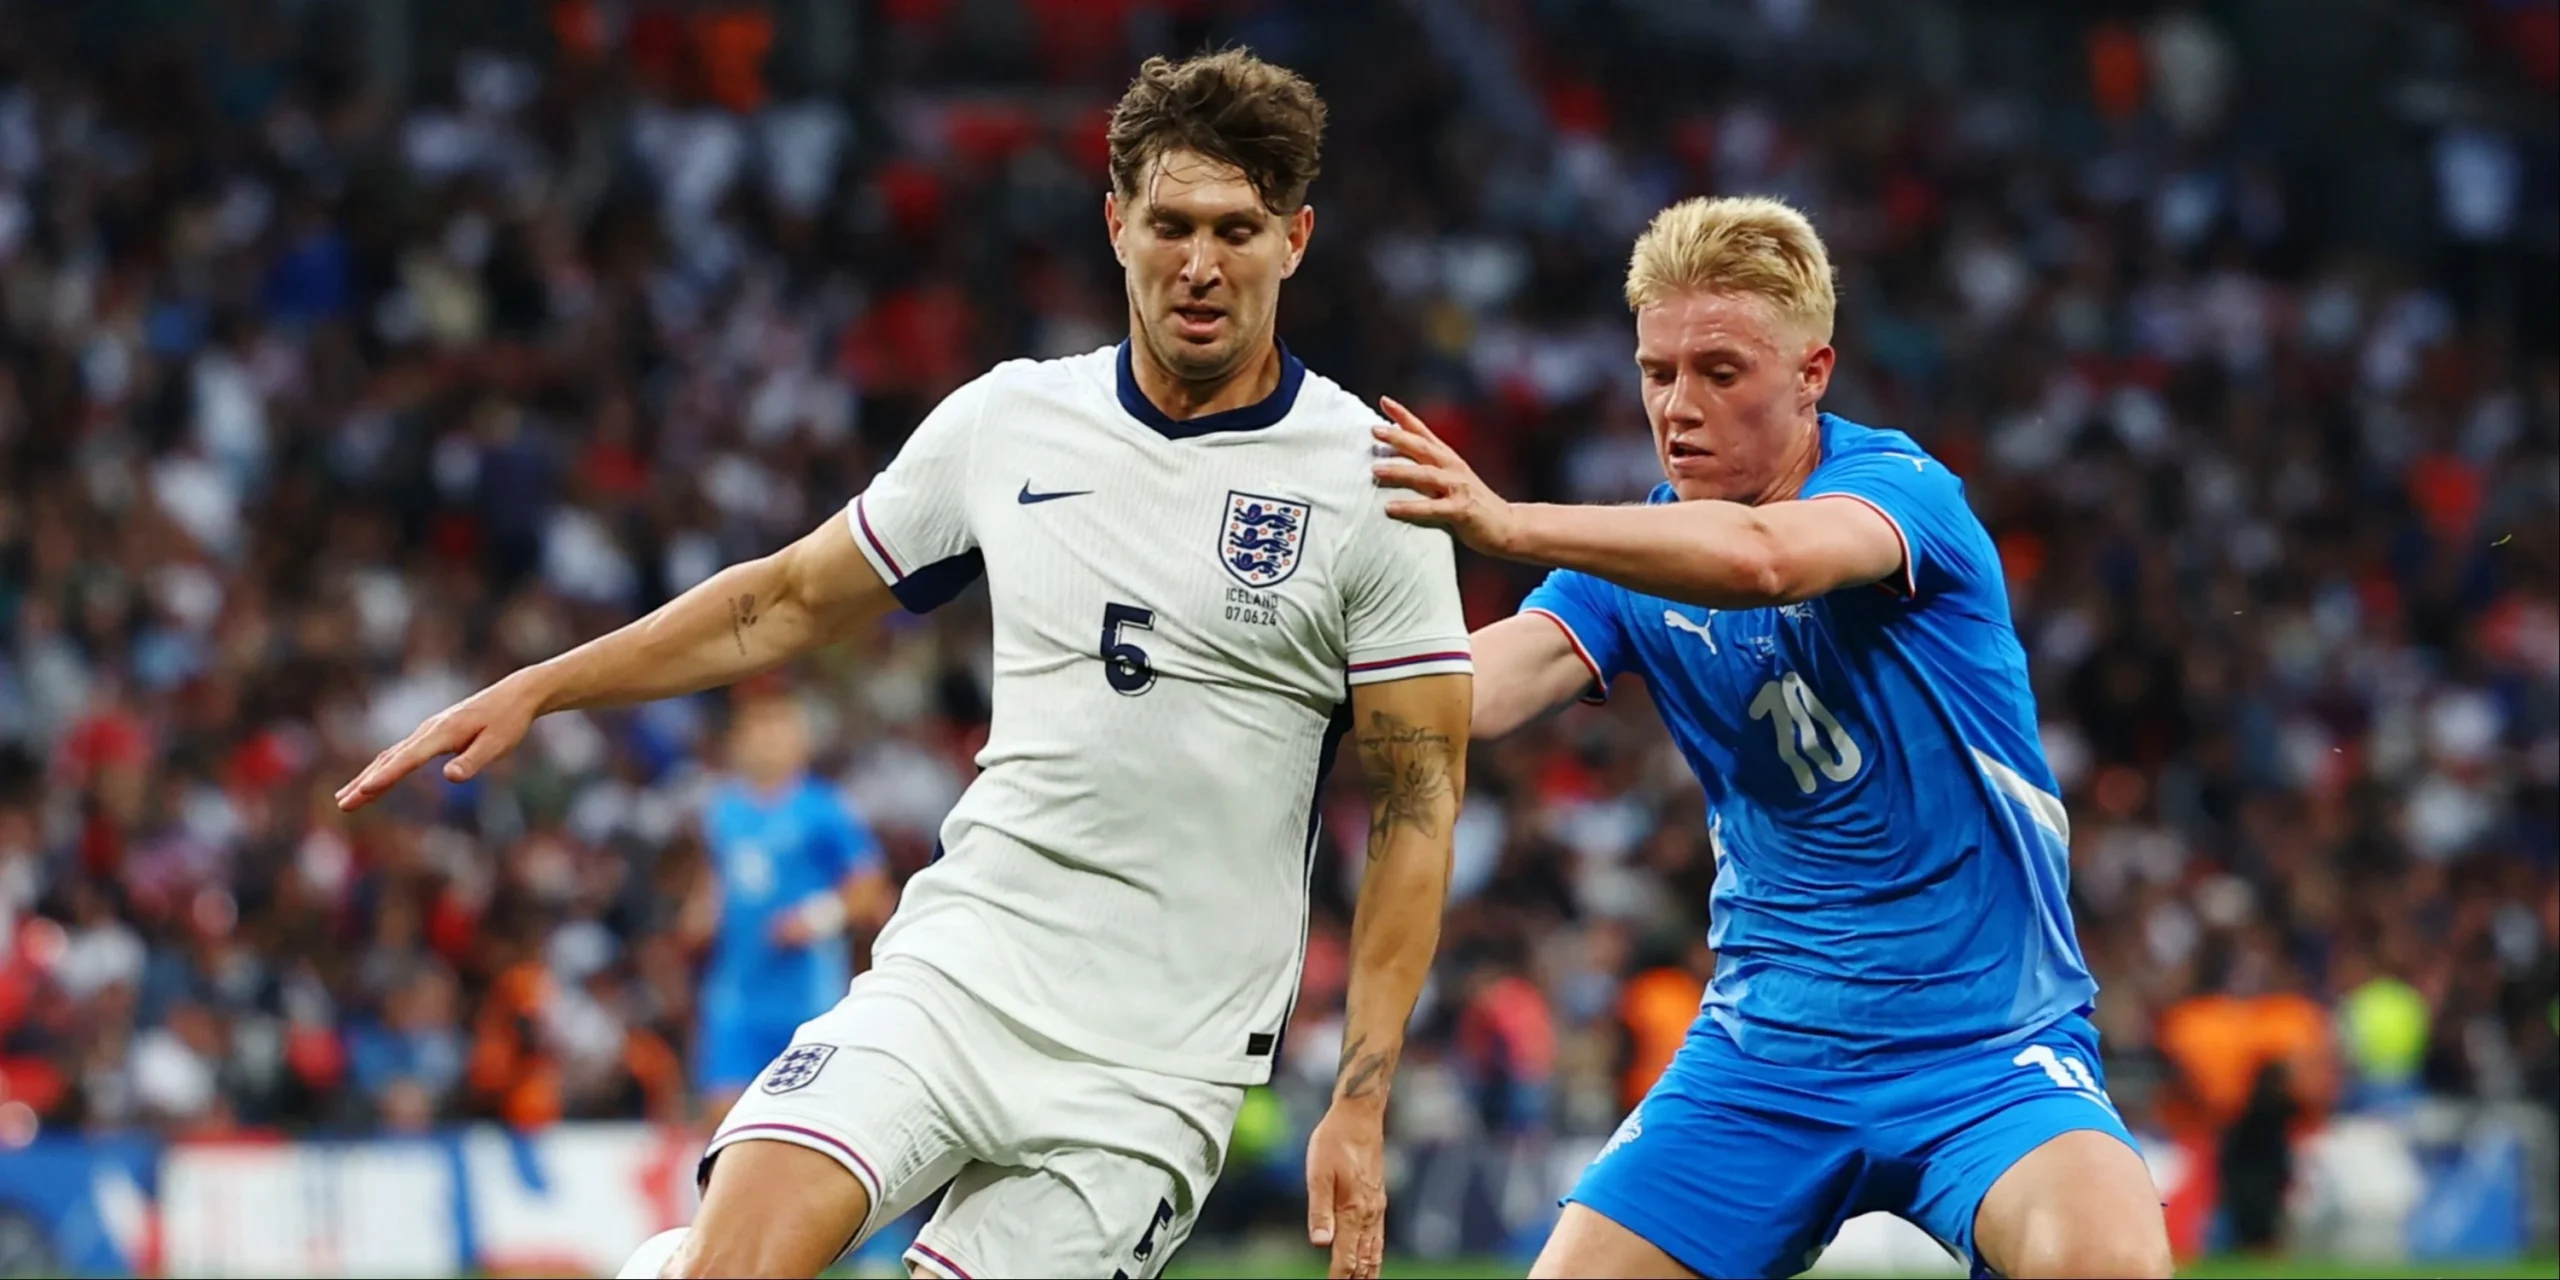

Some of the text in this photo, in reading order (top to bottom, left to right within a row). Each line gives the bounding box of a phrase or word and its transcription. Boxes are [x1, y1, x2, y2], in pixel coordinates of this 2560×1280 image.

[1225, 606, 1277, 626] 07.06.24
[1226, 587, 1278, 610] ICELAND
[1100, 601, 1157, 697] 5
[1748, 671, 1862, 793] 10
